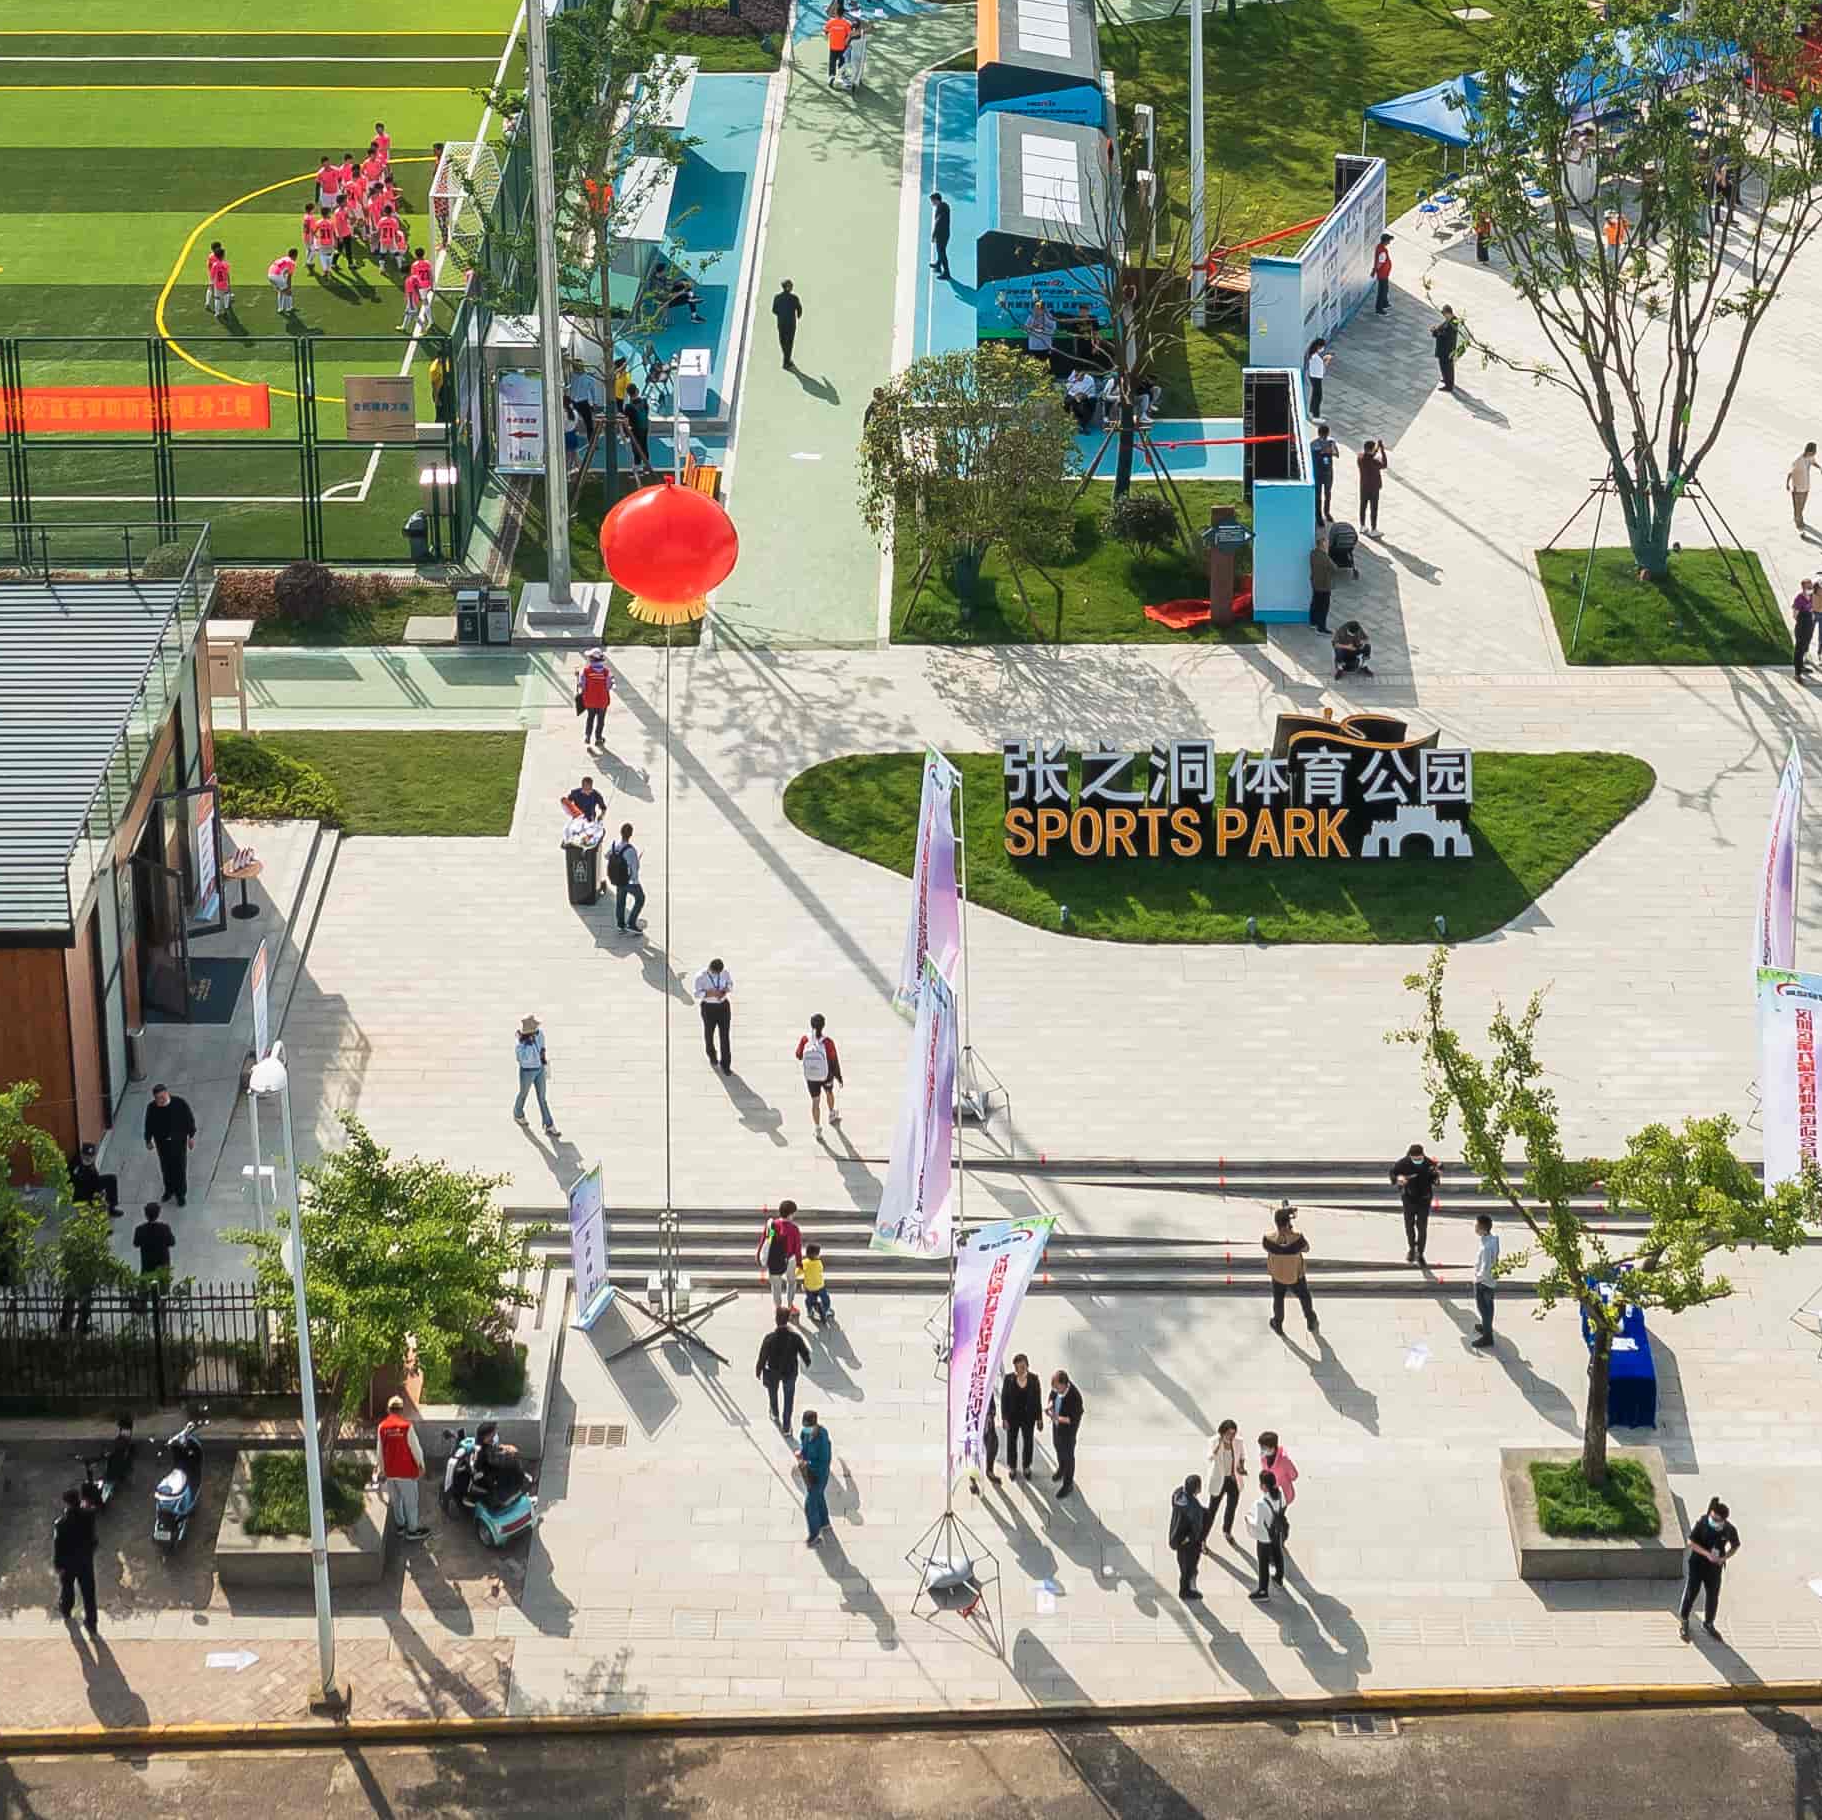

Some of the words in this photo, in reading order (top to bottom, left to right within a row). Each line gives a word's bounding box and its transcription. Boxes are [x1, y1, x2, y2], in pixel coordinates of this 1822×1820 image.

[1004, 738, 1474, 805] 张之洞体育公园
[1004, 808, 1202, 858] SPORTS
[1216, 808, 1350, 858] PARK
